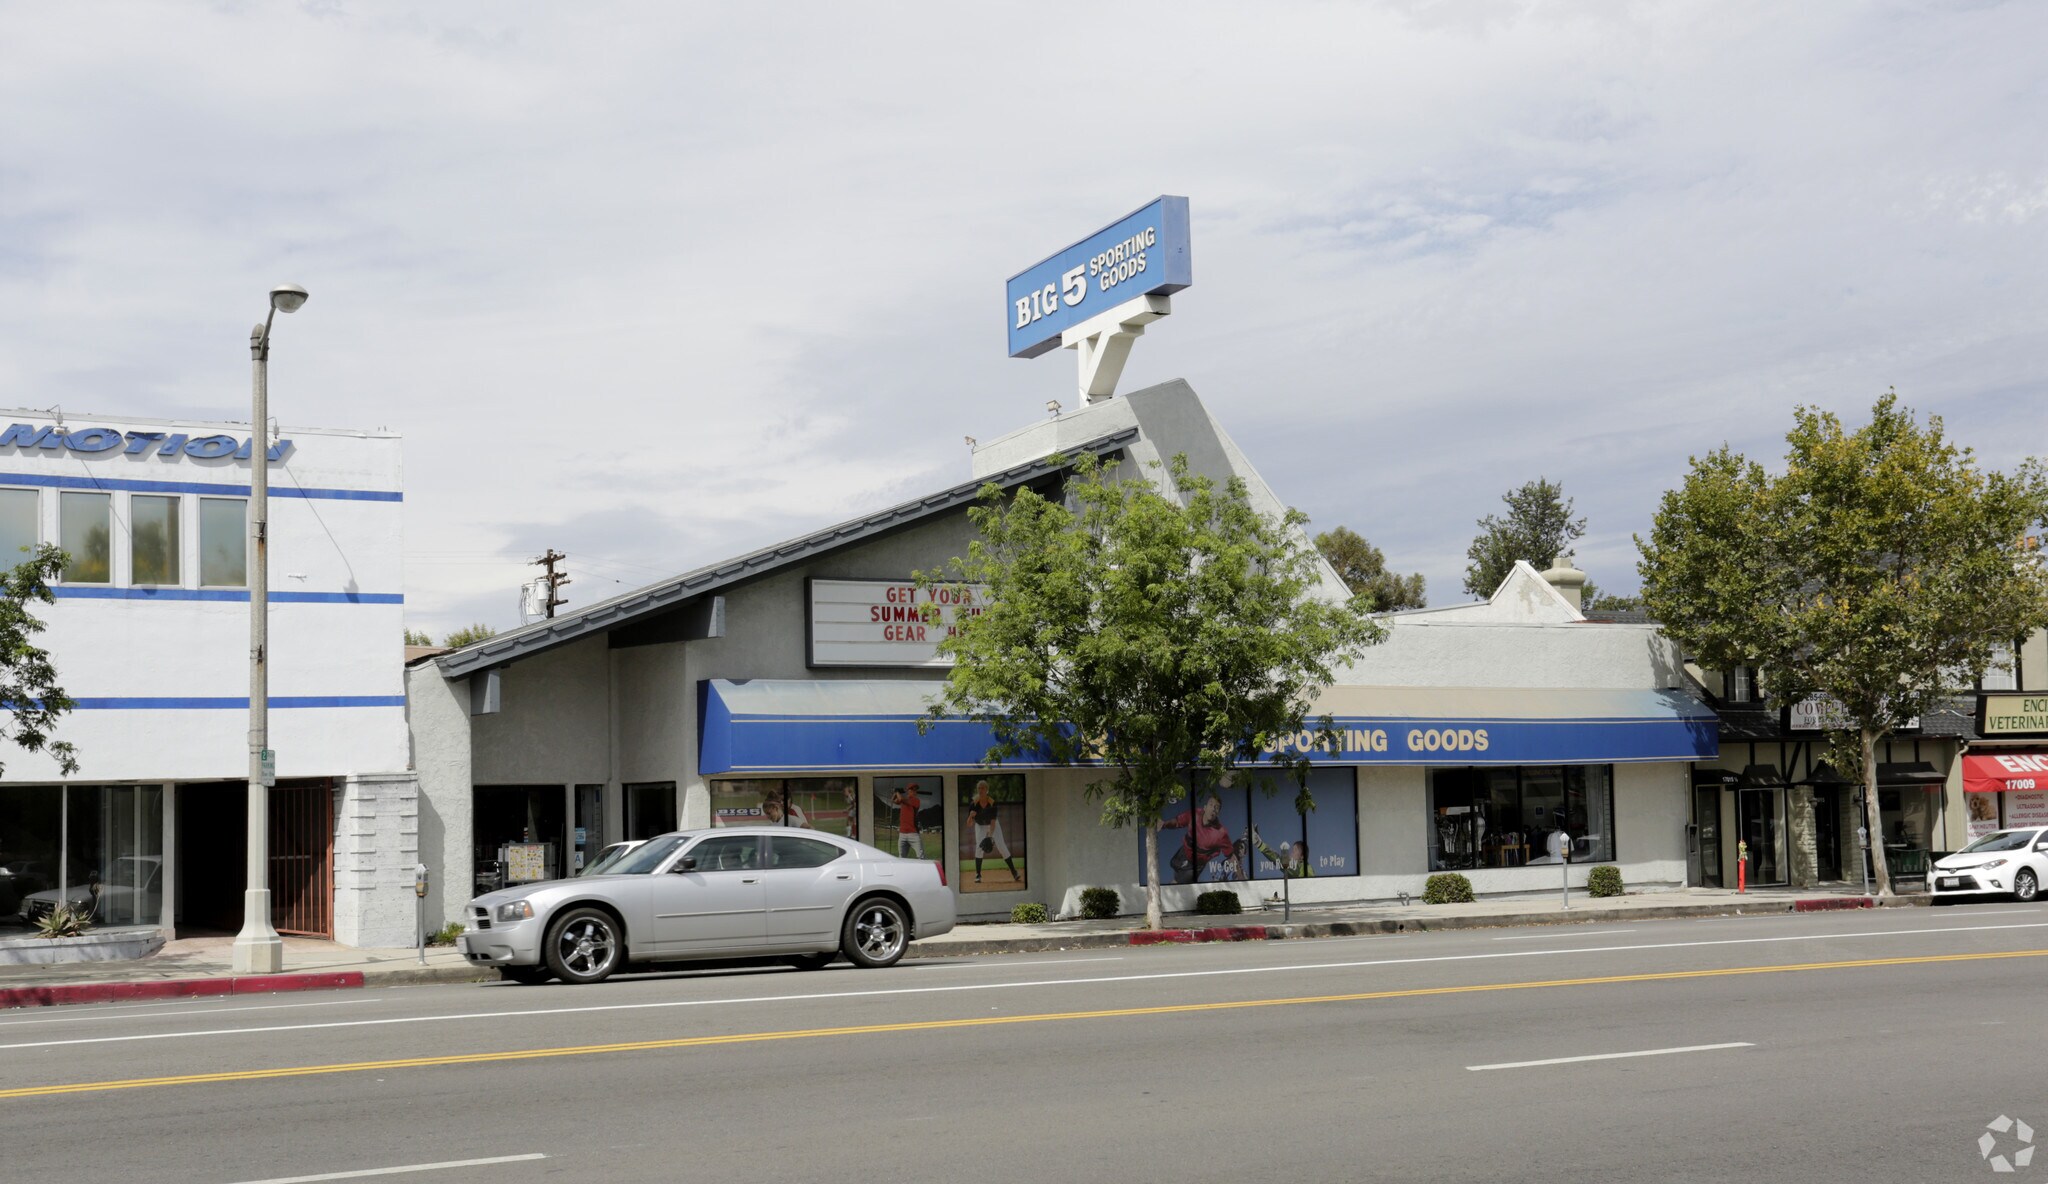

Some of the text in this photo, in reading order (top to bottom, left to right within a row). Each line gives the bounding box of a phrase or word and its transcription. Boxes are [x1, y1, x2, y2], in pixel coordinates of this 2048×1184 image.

[1089, 226, 1156, 277] SPORTING
[1099, 252, 1147, 292] GOODS
[1015, 263, 1088, 329] BIG 5
[0, 423, 292, 461] MOTION
[886, 587, 916, 603] GET
[884, 625, 926, 641] GEAR
[1264, 729, 1388, 753] SPORTING
[1407, 729, 1490, 752] GOODS
[2005, 779, 2036, 790] 17009
[1209, 854, 1345, 873] We Get you Rdy to Play
